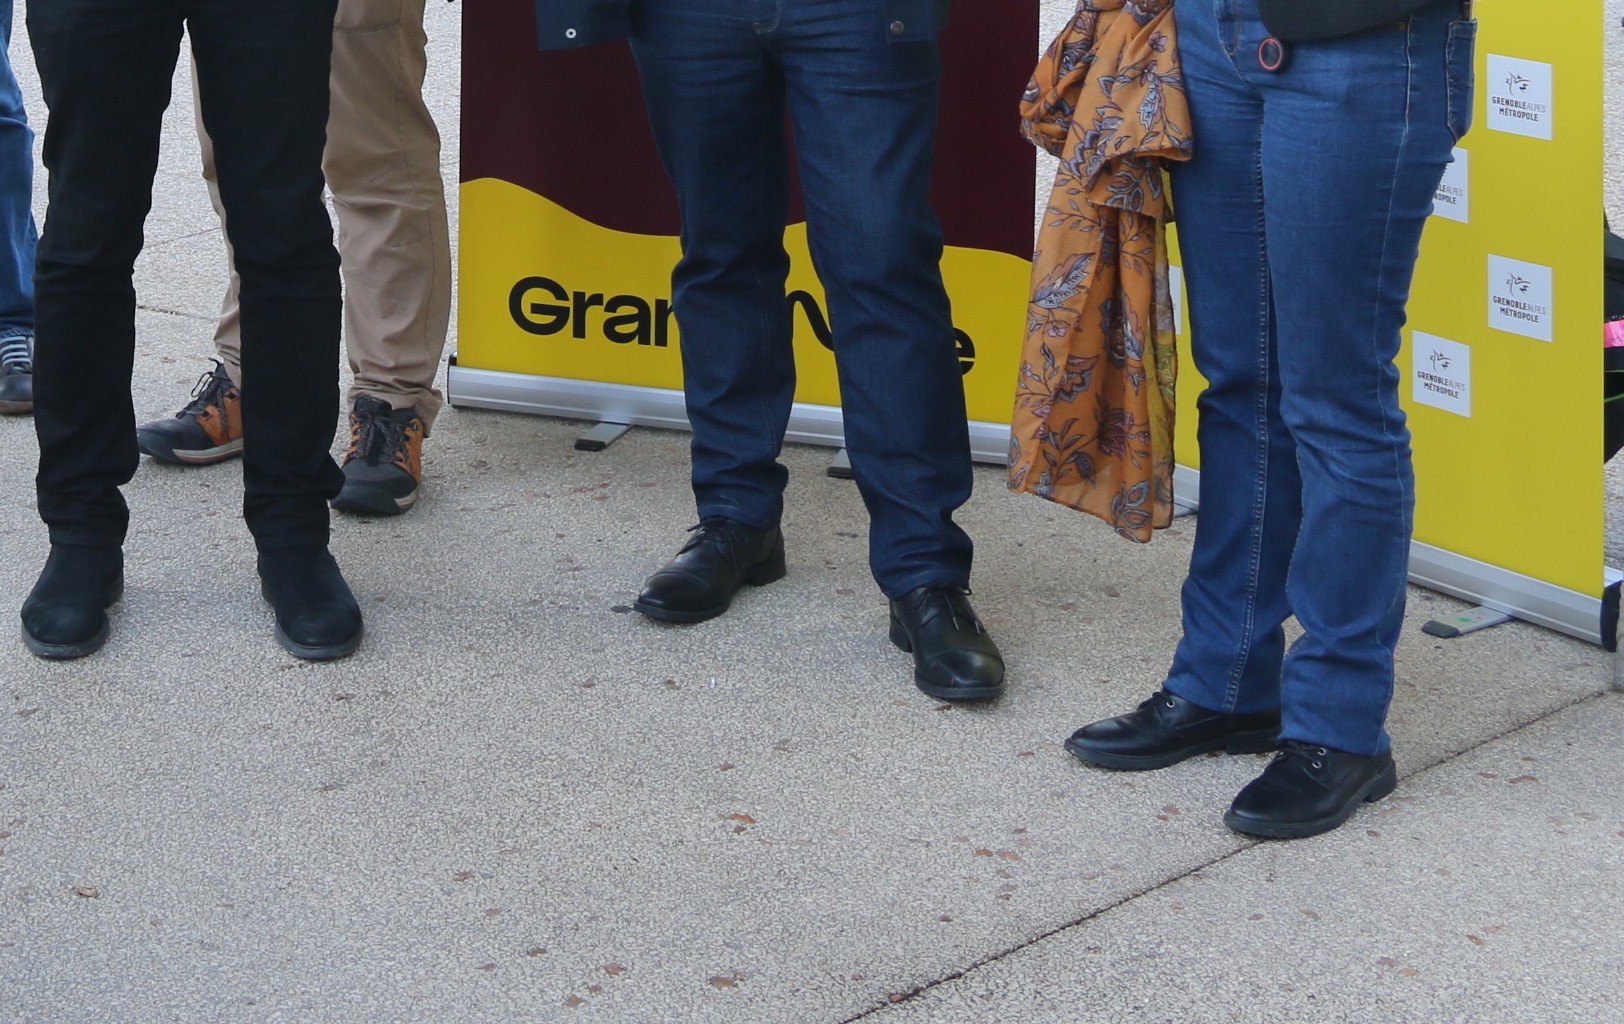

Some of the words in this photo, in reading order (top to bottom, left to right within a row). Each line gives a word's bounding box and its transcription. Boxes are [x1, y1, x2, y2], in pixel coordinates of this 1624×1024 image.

[1499, 107, 1539, 122] MÉTROPOLE
[1499, 307, 1539, 323] MÉTROPOLE
[1423, 381, 1460, 399] MÉTROPOLE
